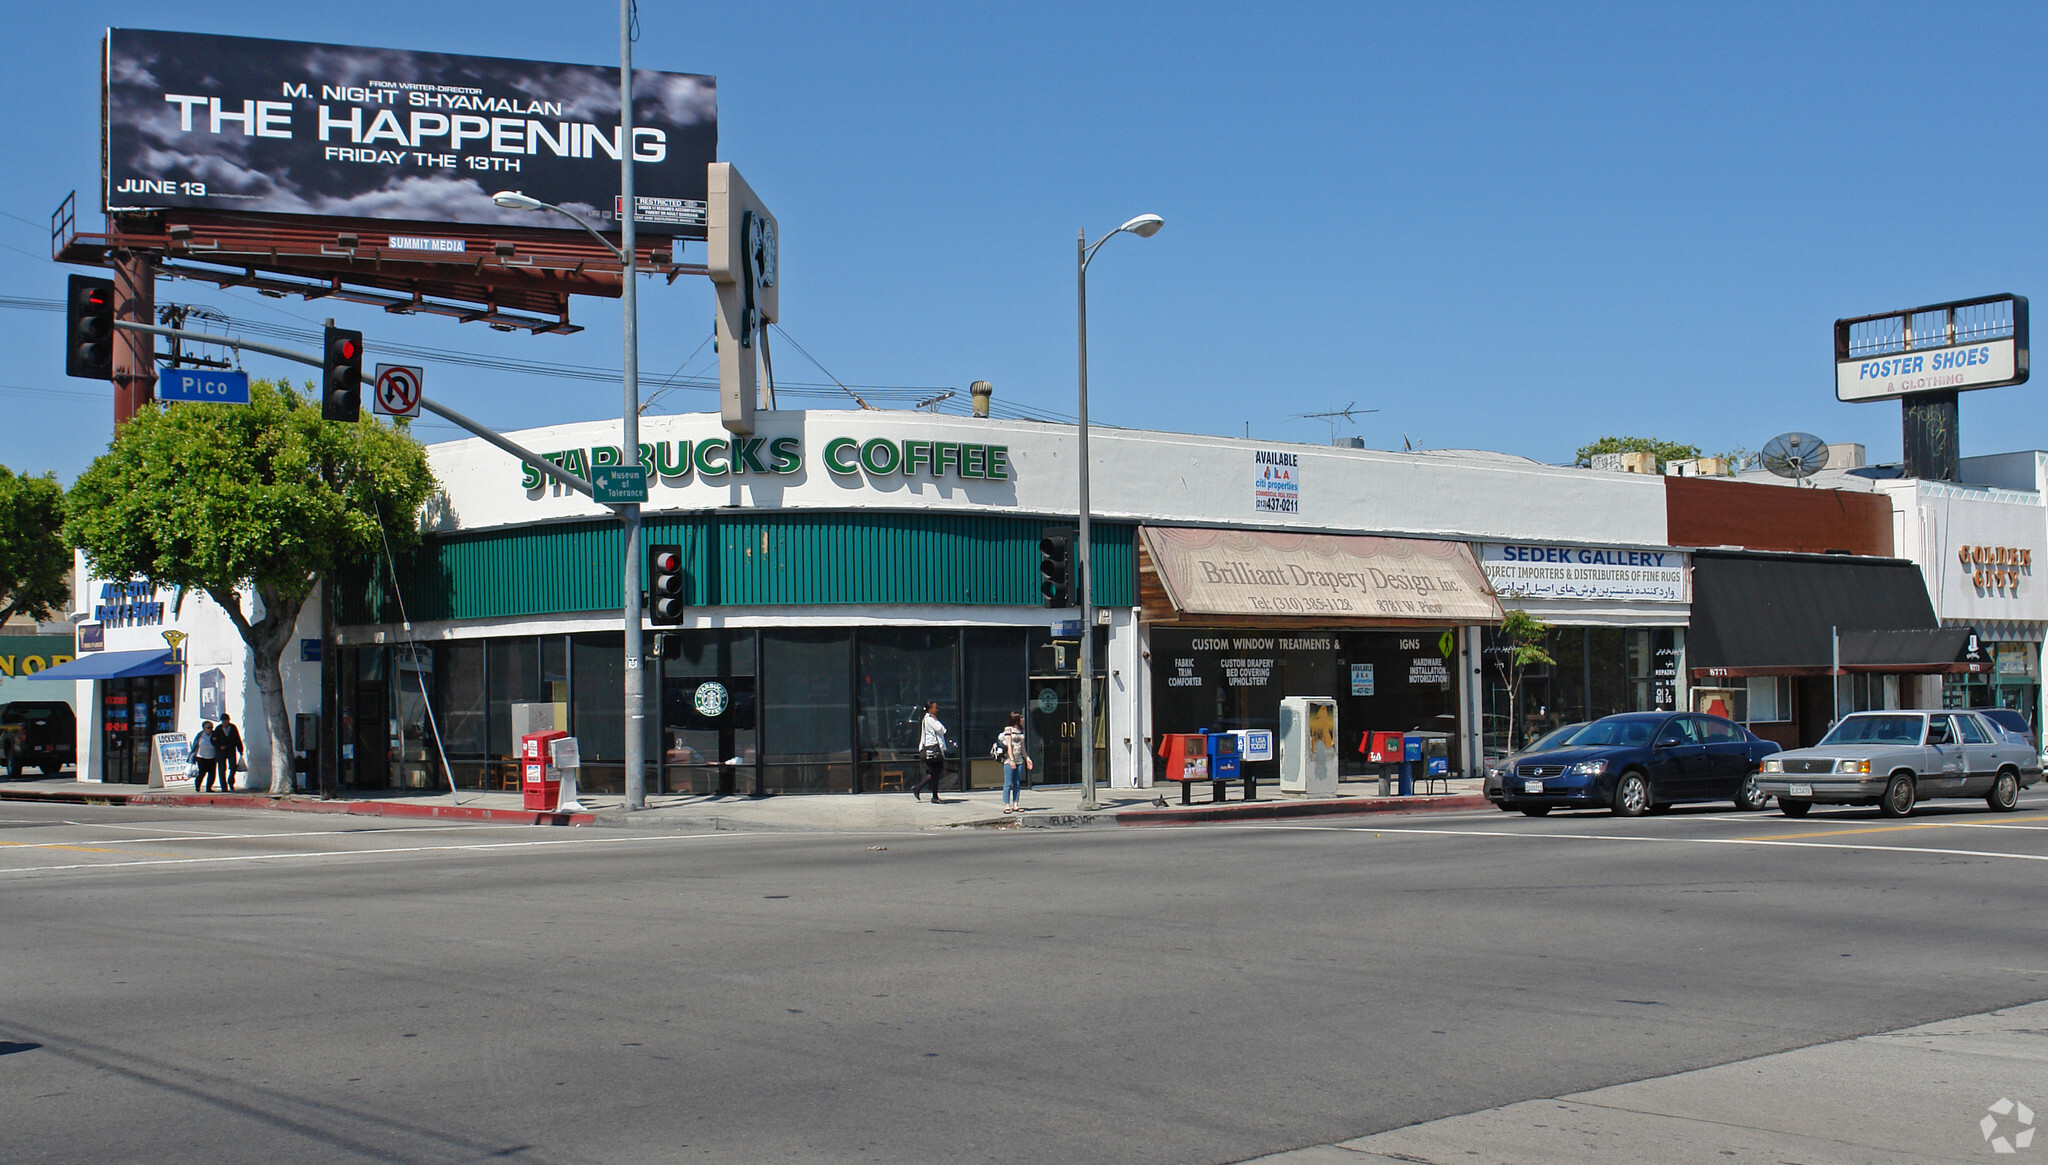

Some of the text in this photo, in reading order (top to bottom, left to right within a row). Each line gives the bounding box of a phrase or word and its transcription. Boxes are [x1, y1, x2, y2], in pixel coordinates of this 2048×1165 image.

[369, 80, 482, 95] FROM WRITER-DIRECTOR
[283, 81, 562, 116] M. NIGHT SHYAMALAN
[164, 93, 666, 163] THE HAPPENING
[325, 146, 520, 172] FRIDAY THE 13TH
[117, 179, 206, 196] JUNE 13
[639, 198, 682, 207] RESTRICTED
[390, 237, 464, 252] SUMMIT MEDIA
[1859, 346, 1990, 380] FOSTER SHOES
[181, 376, 228, 395] Pico
[1887, 373, 1964, 392] & CLOTHING
[822, 437, 1009, 480] COFFEE
[1255, 450, 1298, 467] AVAILABLE
[610, 471, 640, 480] Museum
[621, 480, 630, 488] of
[1255, 479, 1298, 491] citi properties
[608, 489, 644, 497] Tolerance
[1503, 545, 1666, 567] SEDEK GALLERY
[1958, 544, 2031, 567] GOLDEN
[1199, 560, 1462, 596] Brilliant Drapery Design Inc.
[1485, 565, 1681, 583] DIRECT IMPORTERS & DISTRIBUTERS OF FINE RUGS
[1972, 569, 2020, 589] CITY
[95, 604, 118, 620] LOCK
[132, 602, 159, 618] SAFE
[1272, 597, 1304, 612] (310)
[1305, 598, 1354, 611] 385-1128
[1376, 599, 1401, 612] 8781
[1419, 600, 1443, 614] Pico
[1192, 638, 1229, 651] CUSTOM
[1233, 638, 1274, 650] WINDOW
[1279, 639, 1331, 650] TREATMENTS
[1334, 639, 1341, 650] &
[1174, 658, 1194, 668] FABRIC
[1220, 658, 1274, 668] CUSTOM DRAPERY
[1412, 658, 1442, 666] HARDWARE
[1178, 668, 1192, 677] TRIM
[1226, 668, 1270, 677] BED COVERING
[1410, 666, 1447, 675] INSTALLATION
[1709, 668, 1728, 676] 8771
[1168, 677, 1202, 687] COMFORTER
[1228, 677, 1267, 687] UPHOLSTERY
[1408, 674, 1448, 683] MOTORIZATION
[158, 734, 187, 744] LOCKSMITH
